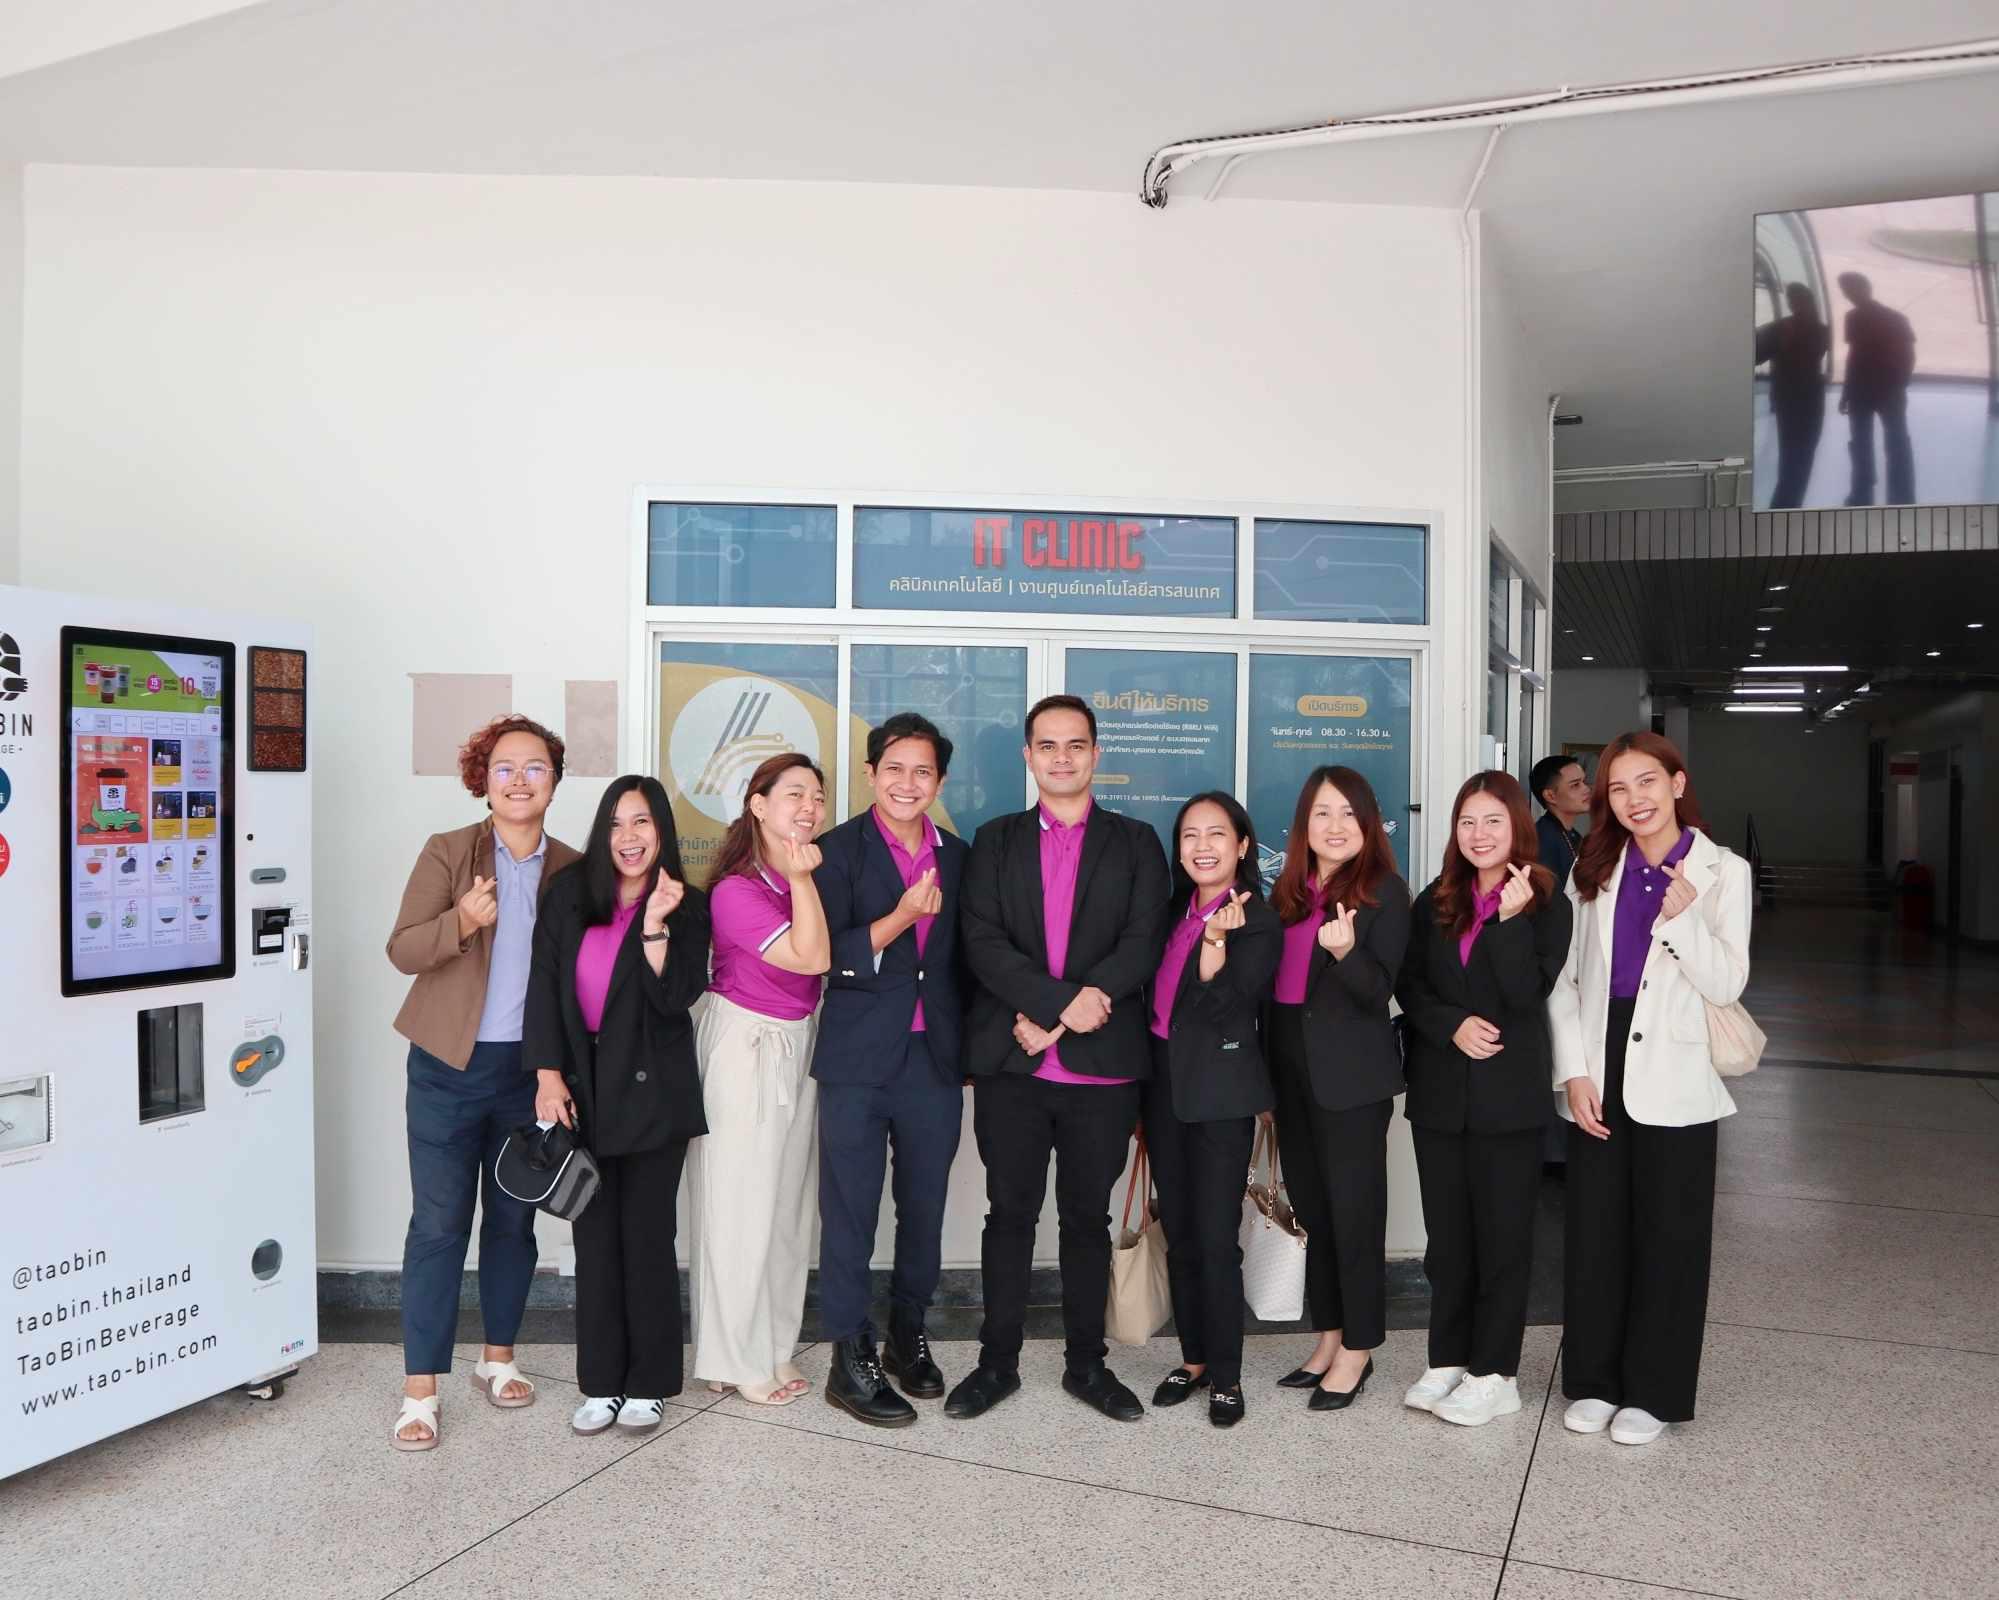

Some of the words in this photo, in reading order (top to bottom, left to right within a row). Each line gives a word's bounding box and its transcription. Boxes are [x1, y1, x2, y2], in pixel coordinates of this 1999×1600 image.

[973, 517, 1009, 568] IT
[1022, 518, 1144, 571] CLINIC
[889, 575, 1003, 593] คลินิกเทคโนโลยี
[1019, 578, 1221, 600] งานศูนย์เทคโนโลยีสารสนเทศ
[1092, 689, 1210, 712] ยินดีให้บริการ
[0, 713, 32, 736] BIN
[1320, 727, 1346, 737] 08.30
[1356, 728, 1380, 737] 16.30
[12, 1249, 106, 1290] @taobin
[16, 1264, 192, 1334] taobin.thailand
[17, 1302, 200, 1376] TaoBinBeverage
[22, 1333, 218, 1416] www.tao-bin.com
